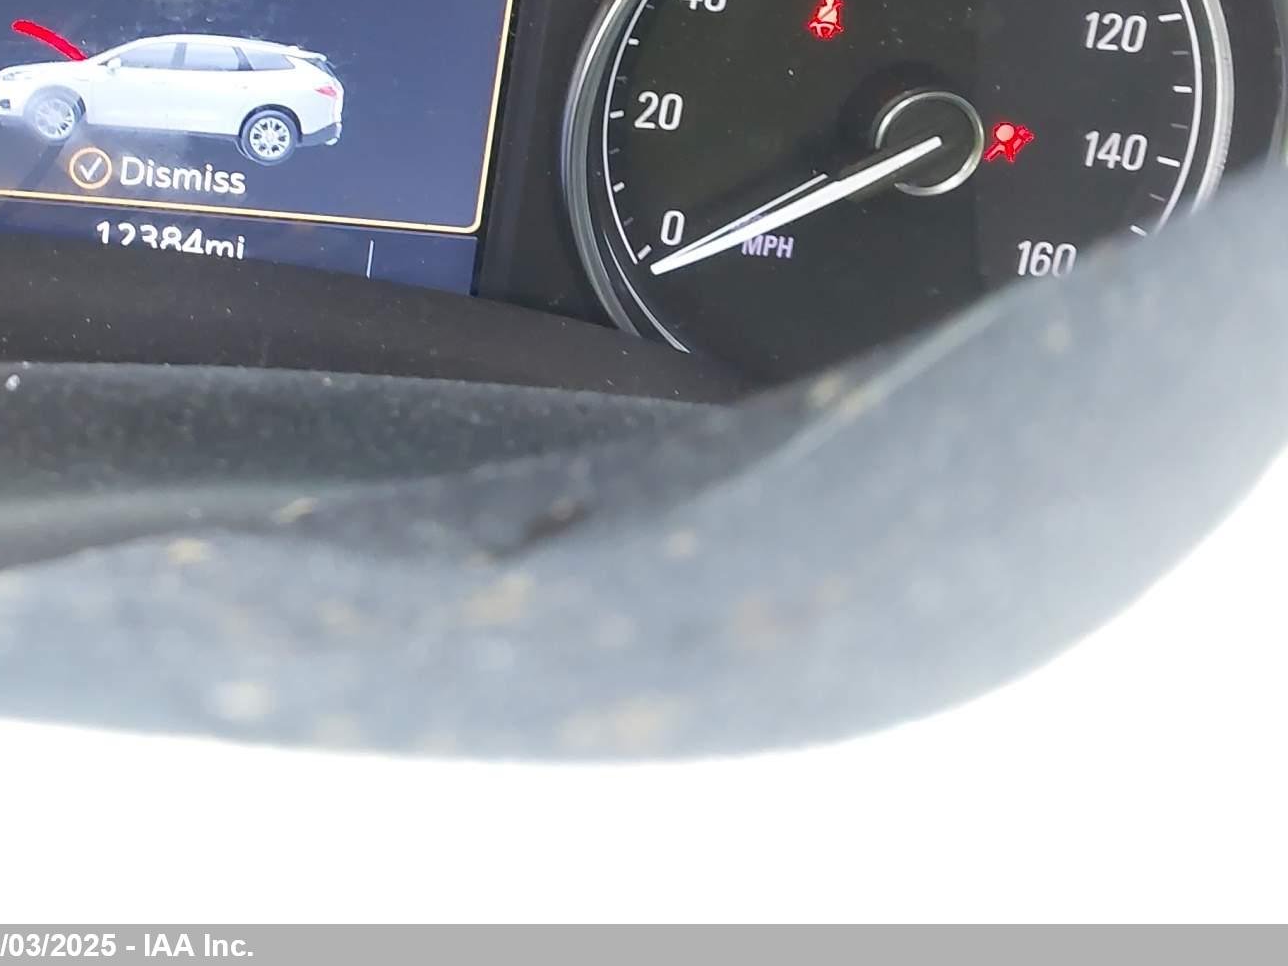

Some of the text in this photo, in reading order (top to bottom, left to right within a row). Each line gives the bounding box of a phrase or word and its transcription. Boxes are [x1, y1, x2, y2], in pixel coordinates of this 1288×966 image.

[1084, 11, 1147, 53] 120
[634, 91, 684, 131] 20
[1085, 130, 1148, 171] 140
[119, 156, 247, 195] Dismiss
[96, 220, 246, 260] 12384mi
[660, 210, 686, 247] 0
[741, 234, 794, 259] MPH
[1017, 240, 1078, 277] 160
